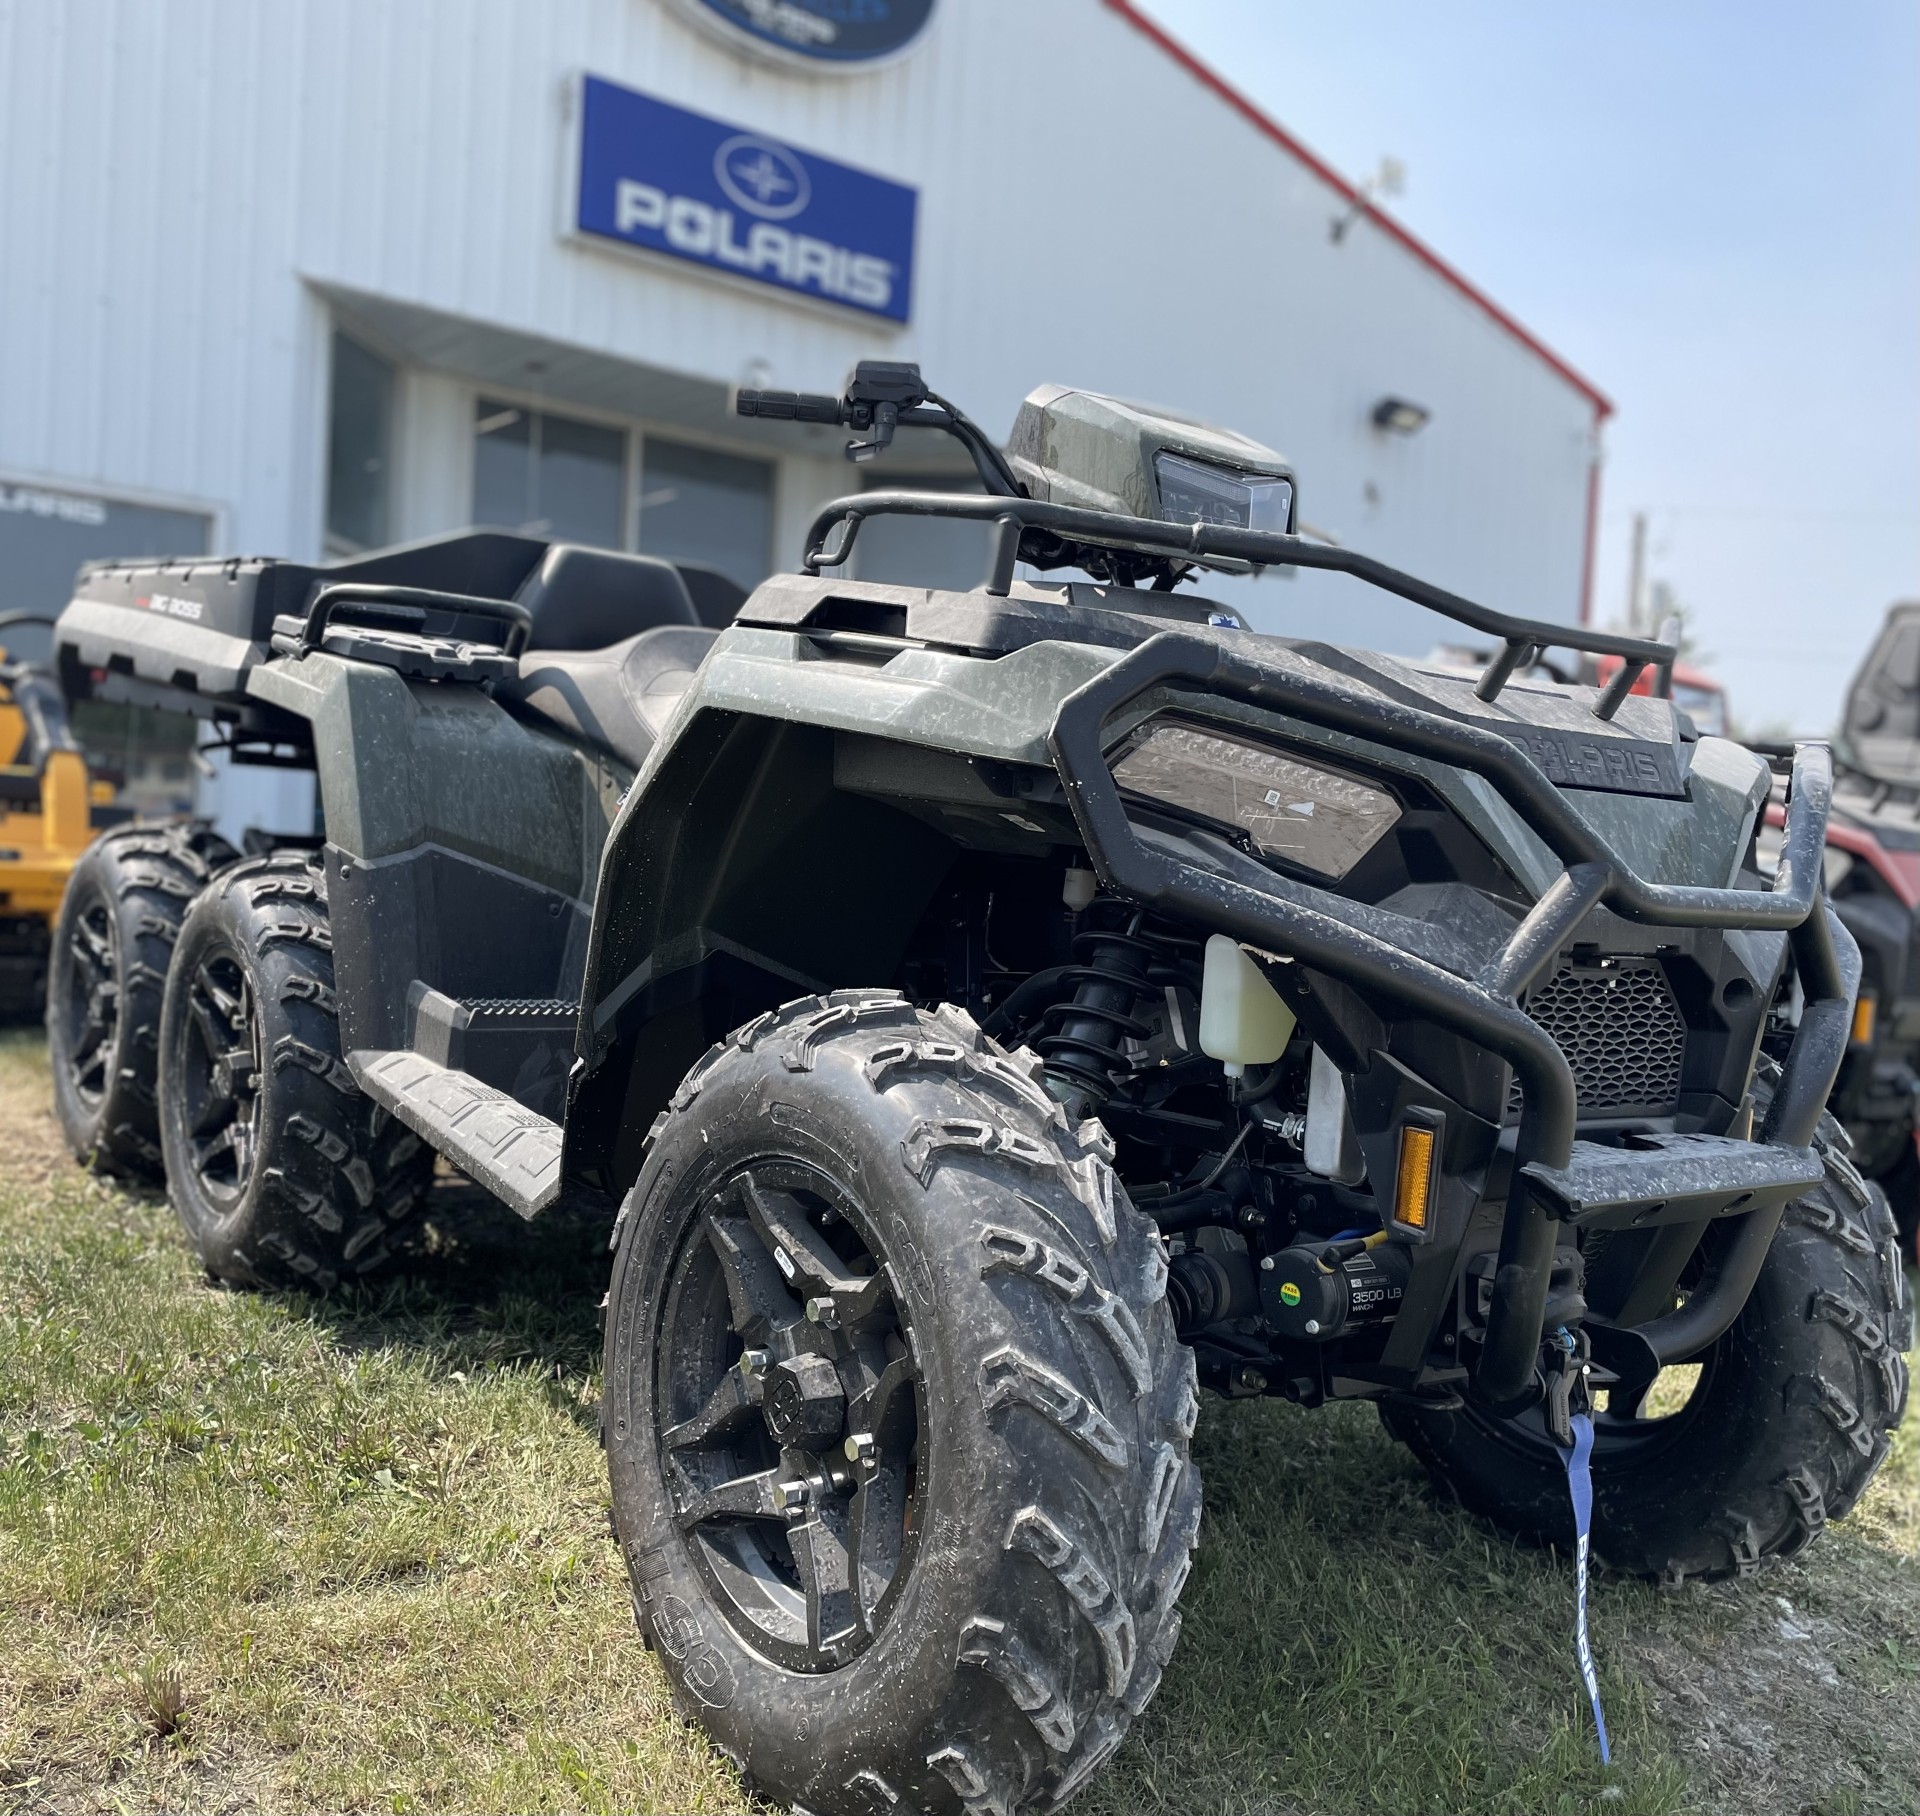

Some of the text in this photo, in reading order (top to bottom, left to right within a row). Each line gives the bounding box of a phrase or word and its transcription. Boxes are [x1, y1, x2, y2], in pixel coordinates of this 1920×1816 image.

[615, 178, 894, 309] POLARIS
[149, 593, 169, 612] BIG
[168, 597, 204, 619] BOSS
[1504, 735, 1660, 782] POLARIS
[1352, 1289, 1384, 1304] 3500
[1352, 1303, 1374, 1312] WINCH
[627, 1540, 736, 1709] CST
[1578, 1533, 1598, 1701] POLARIS
